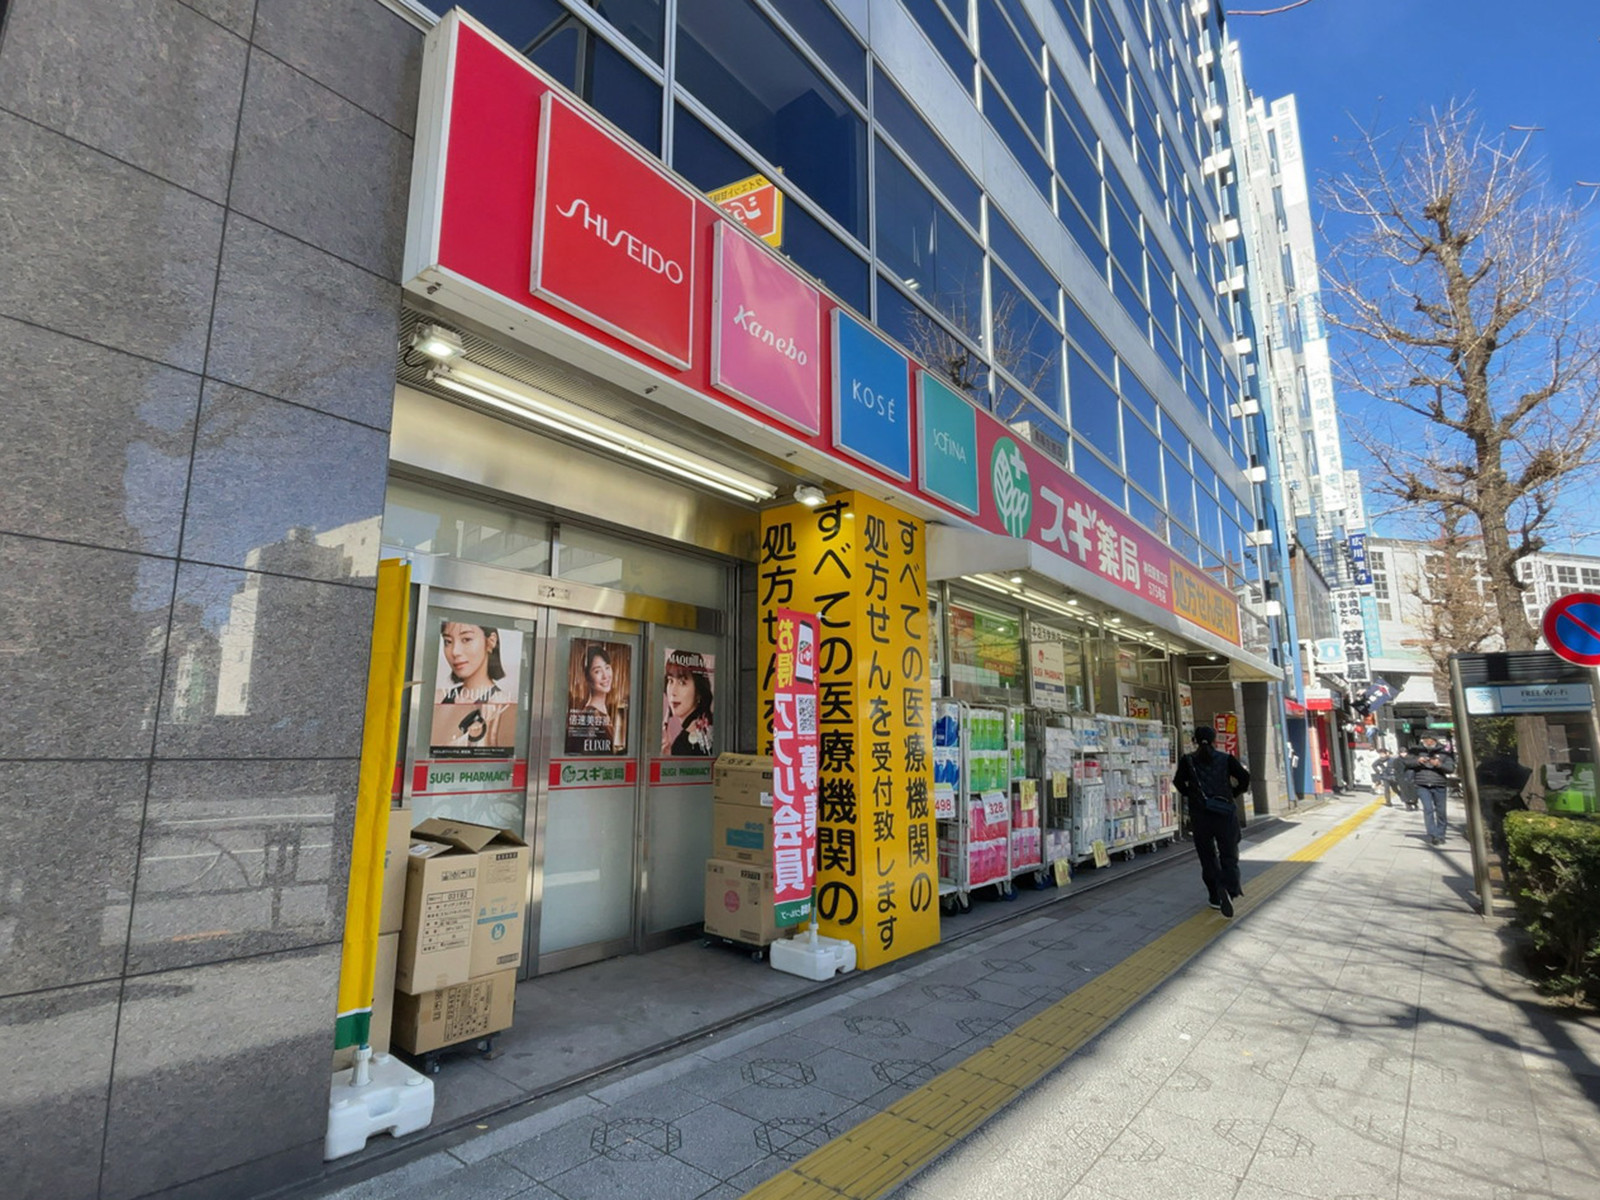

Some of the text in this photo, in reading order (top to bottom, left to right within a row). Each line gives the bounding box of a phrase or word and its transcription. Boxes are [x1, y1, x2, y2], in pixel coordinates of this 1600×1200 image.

[556, 198, 684, 286] SHISEIDO
[734, 304, 808, 367] Kanebo
[852, 378, 896, 424] KOSÉ
[933, 428, 967, 464] SOFINA
[1039, 485, 1142, 591] スギ薬局
[864, 515, 899, 952] 処方せんを受付致します
[897, 519, 932, 913] すべての医療機関の
[583, 738, 612, 751] ELIXIR
[429, 770, 512, 784] SUGI PHARMACY
[576, 766, 625, 783] スギ薬局
[935, 799, 952, 812] 498
[988, 801, 1005, 815] 328
